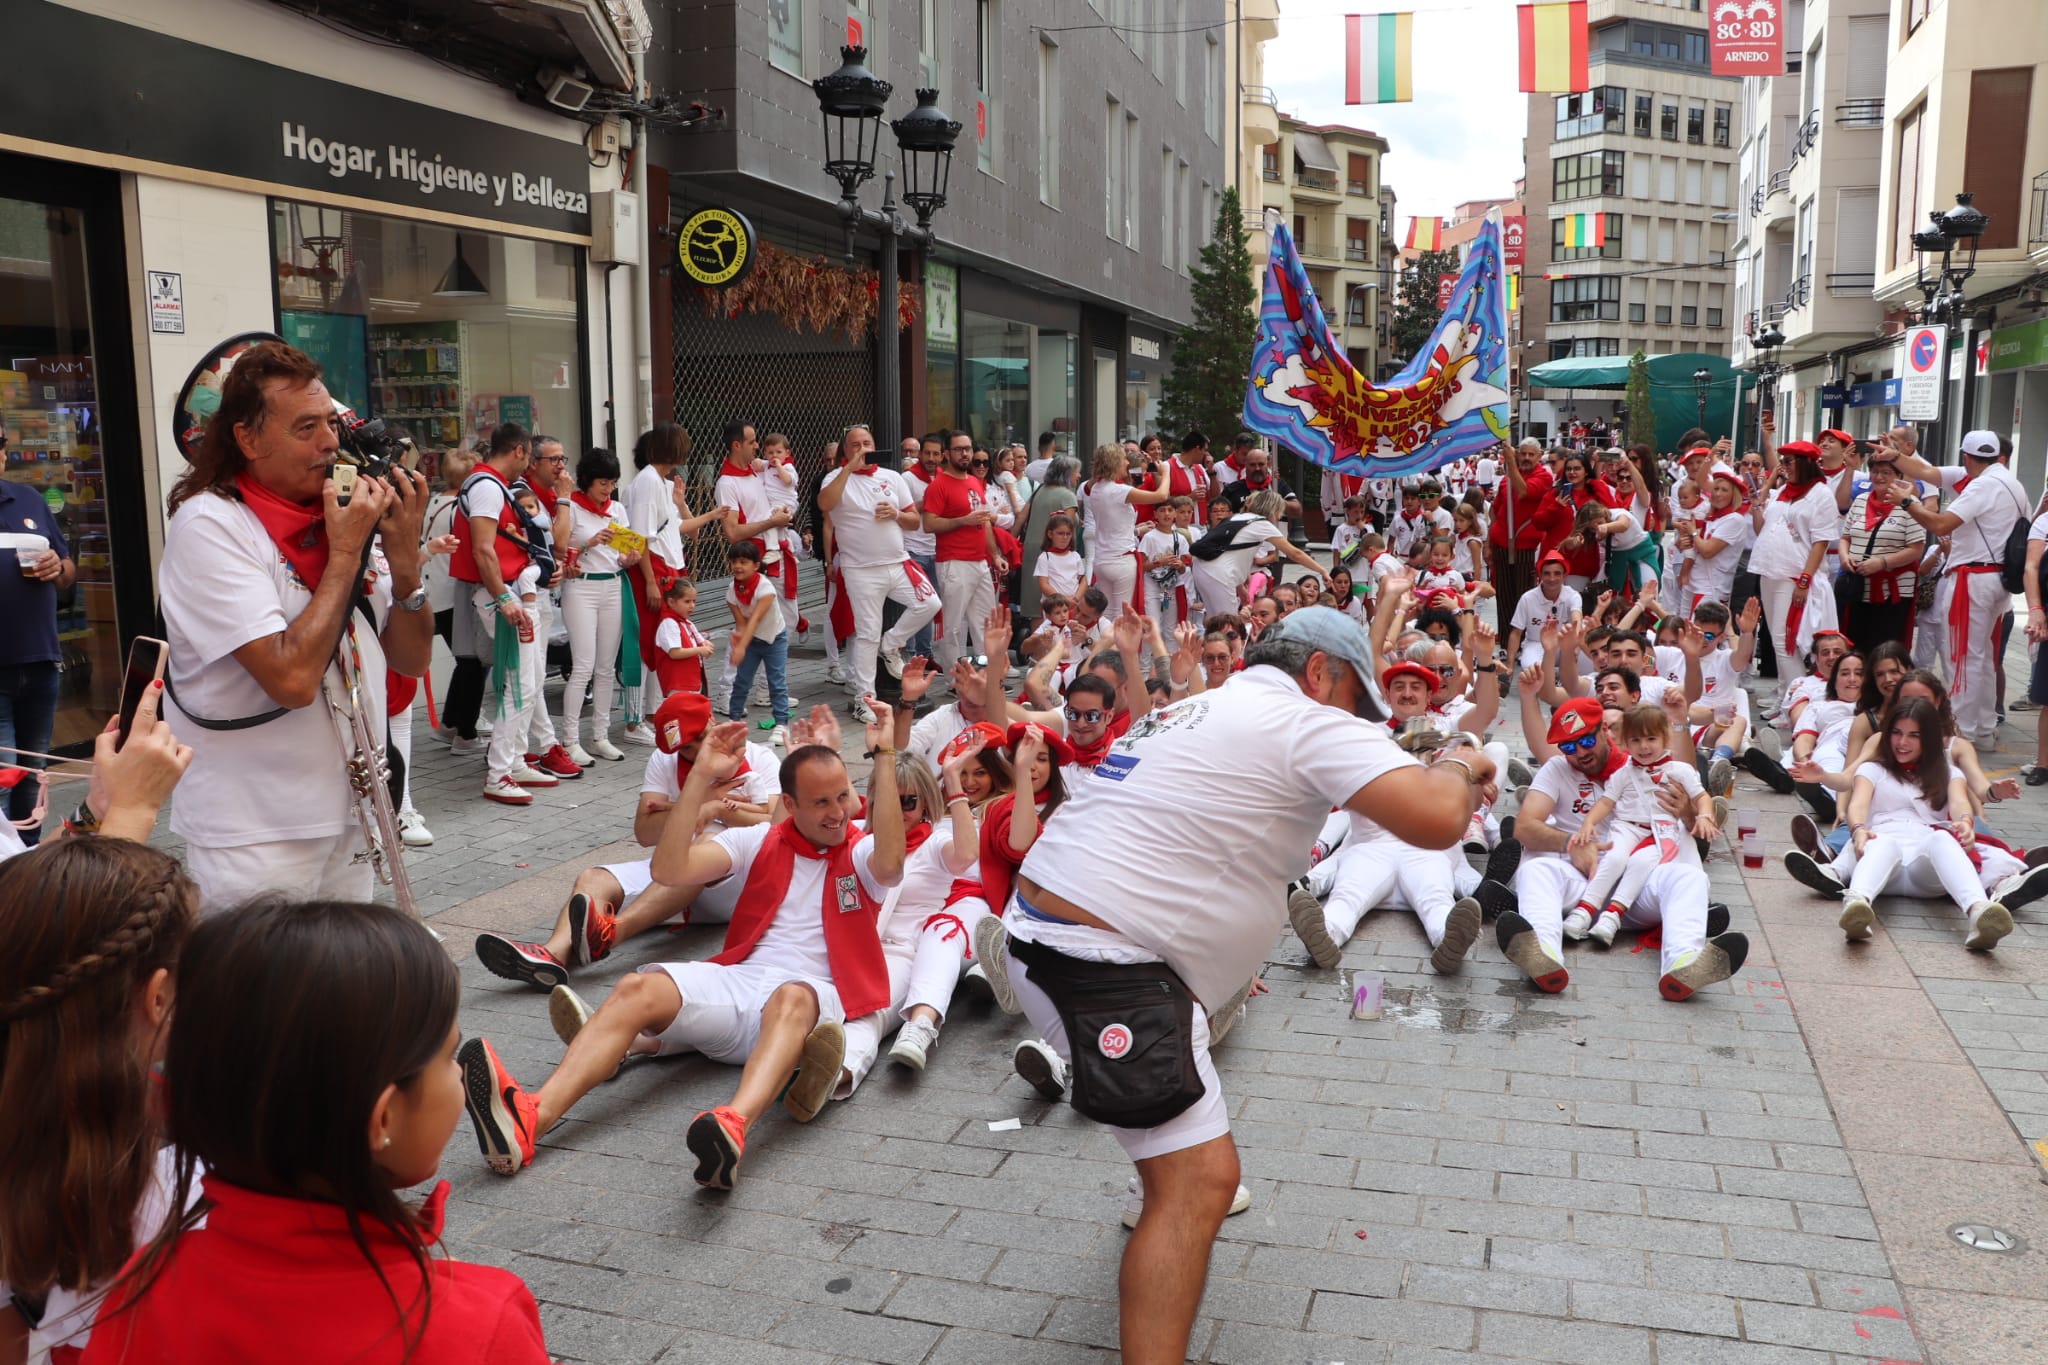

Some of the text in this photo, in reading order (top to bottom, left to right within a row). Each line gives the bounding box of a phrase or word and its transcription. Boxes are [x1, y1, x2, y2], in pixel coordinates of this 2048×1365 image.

[1717, 22, 1741, 39] SC
[1750, 21, 1775, 38] SD
[1725, 51, 1769, 62] ARNEDO
[282, 121, 588, 215] Hogar, Higiene y Belleza
[681, 224, 694, 256] FLORES
[694, 212, 709, 224] POR
[712, 211, 733, 224] TODO
[735, 235, 745, 267] MUNDO
[686, 262, 732, 281] INTERFLORA
[1103, 1032, 1126, 1049] 50
